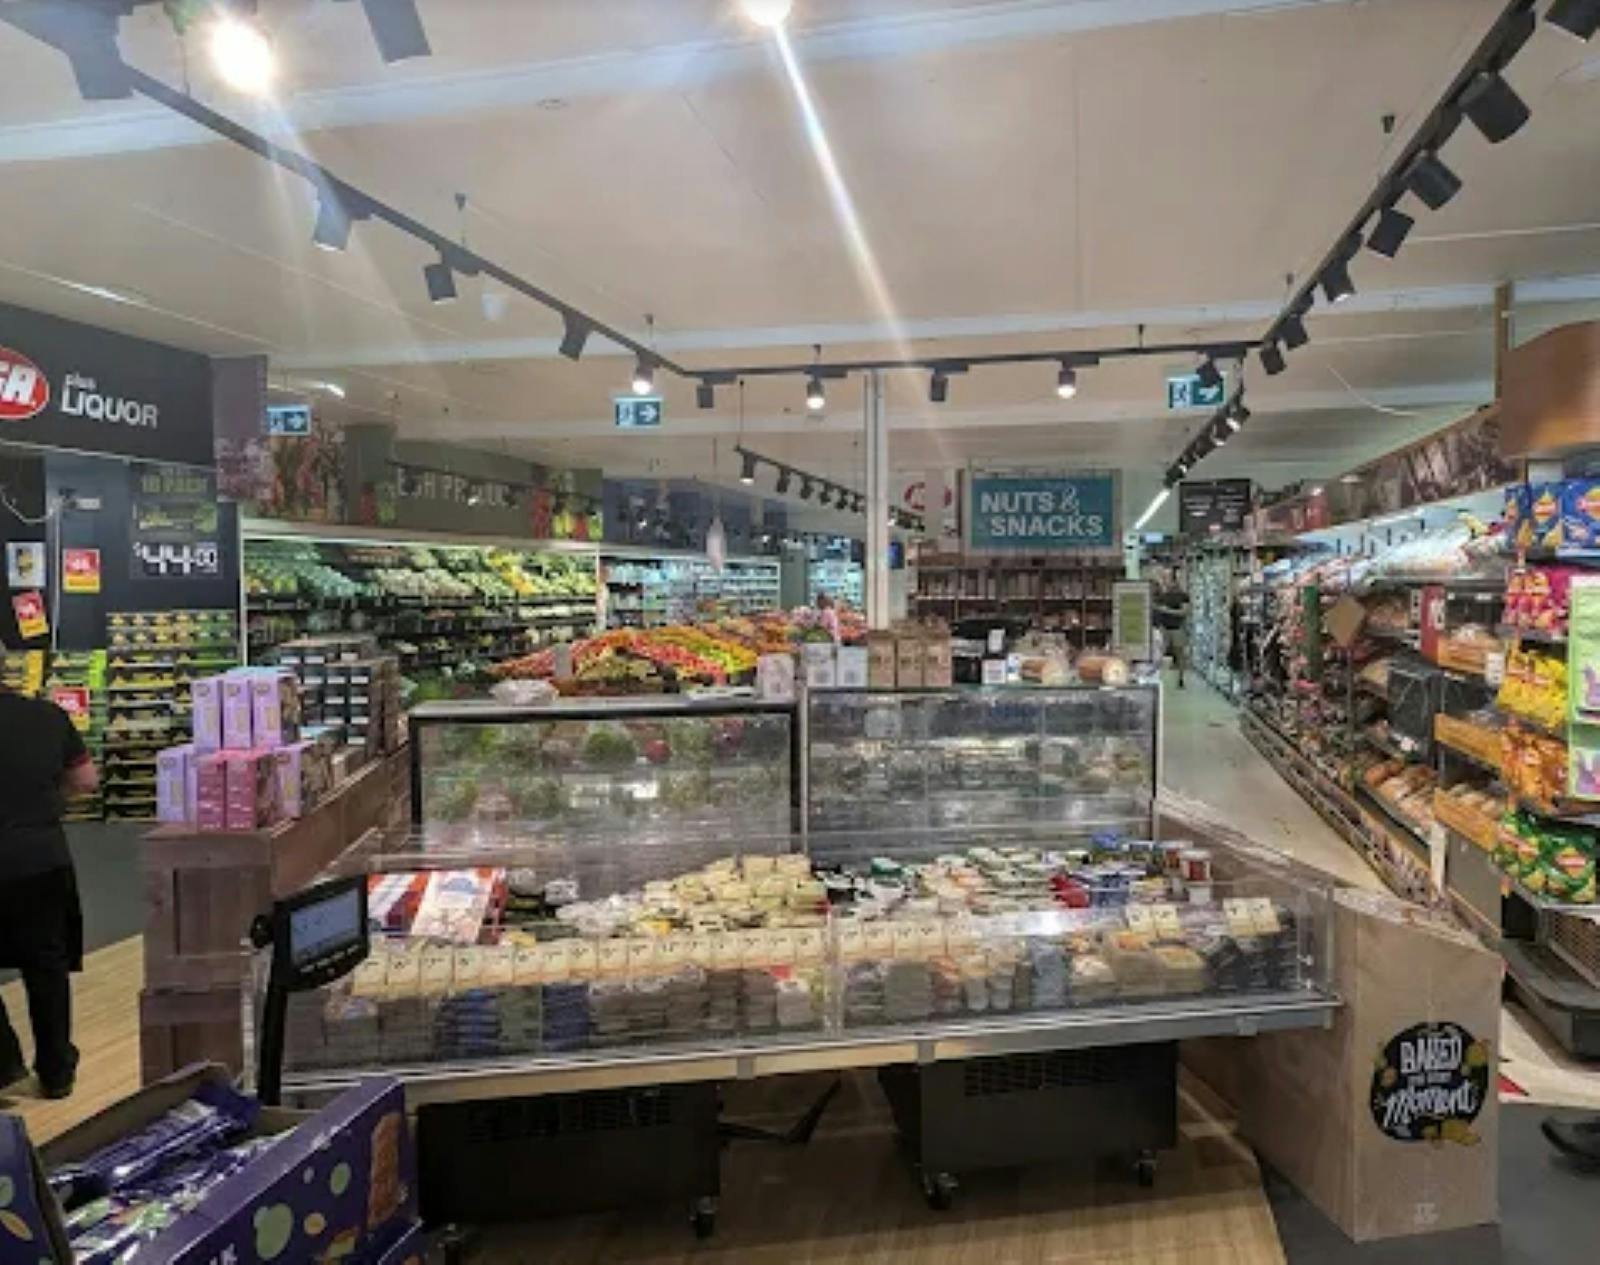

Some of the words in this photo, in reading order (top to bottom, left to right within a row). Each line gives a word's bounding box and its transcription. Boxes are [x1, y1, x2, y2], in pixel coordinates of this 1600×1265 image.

[60, 386, 159, 429] LIQUOR
[980, 491, 1054, 515] NUTS
[1059, 485, 1080, 517] &
[990, 516, 1104, 538] SNACKS
